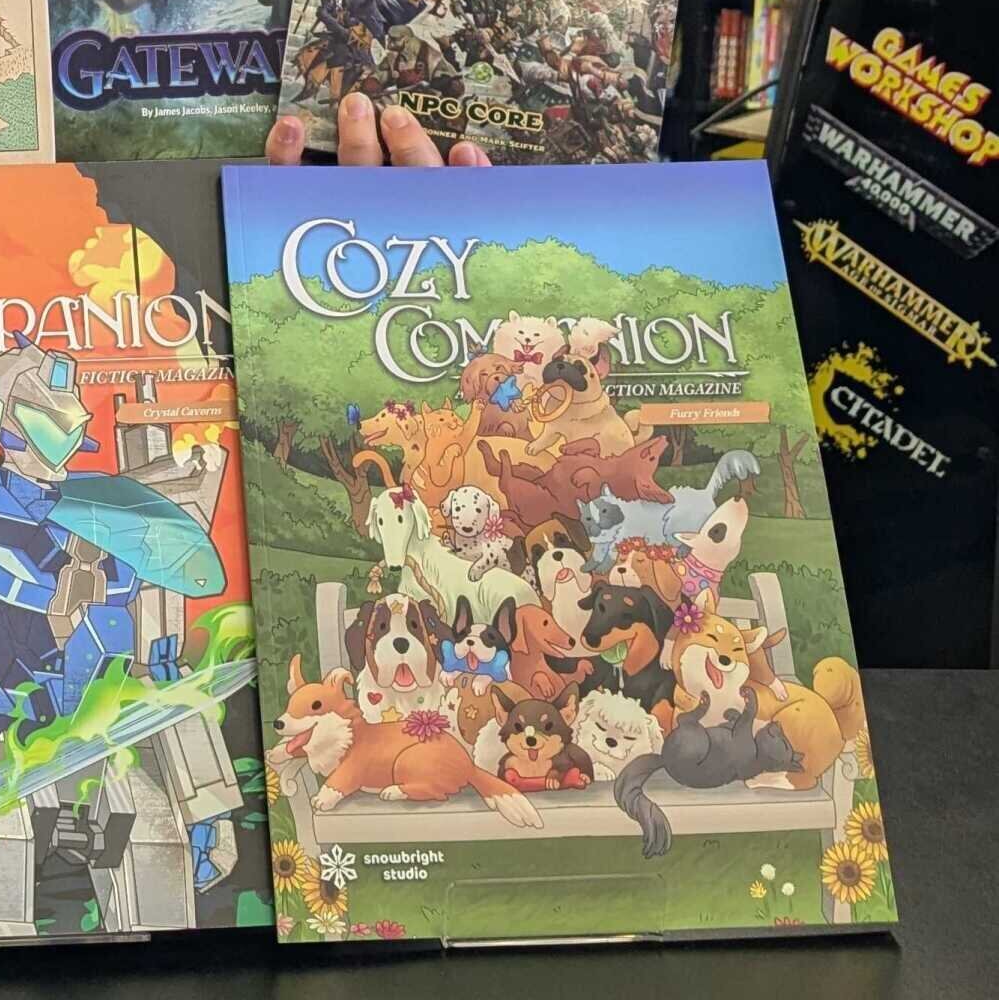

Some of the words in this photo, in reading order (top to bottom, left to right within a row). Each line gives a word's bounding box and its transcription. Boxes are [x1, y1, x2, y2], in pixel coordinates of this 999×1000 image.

[58, 38, 284, 100] GATEWA
[872, 26, 992, 115] GAMES
[141, 106, 153, 118] By
[154, 105, 180, 118] James
[181, 104, 213, 117] Jacobs,
[214, 103, 238, 116] Jason
[239, 102, 271, 114] Keeley,
[400, 91, 461, 119] NPC
[466, 101, 544, 132] CORE
[825, 26, 999, 167] WORKSHOP
[818, 121, 976, 246] WARHAMMER
[860, 177, 911, 216] 40,000
[282, 217, 480, 318] COZY
[810, 226, 977, 357] WARHAMMER
[659, 382, 742, 396] MAGAZINE
[143, 407, 179, 419] Crystal
[181, 406, 222, 417] Caverns
[670, 408, 702, 420] Furry
[703, 407, 741, 418] Friends
[830, 385, 953, 480] CITADEL
[363, 850, 445, 866] snowbright
[383, 867, 429, 880] studio
